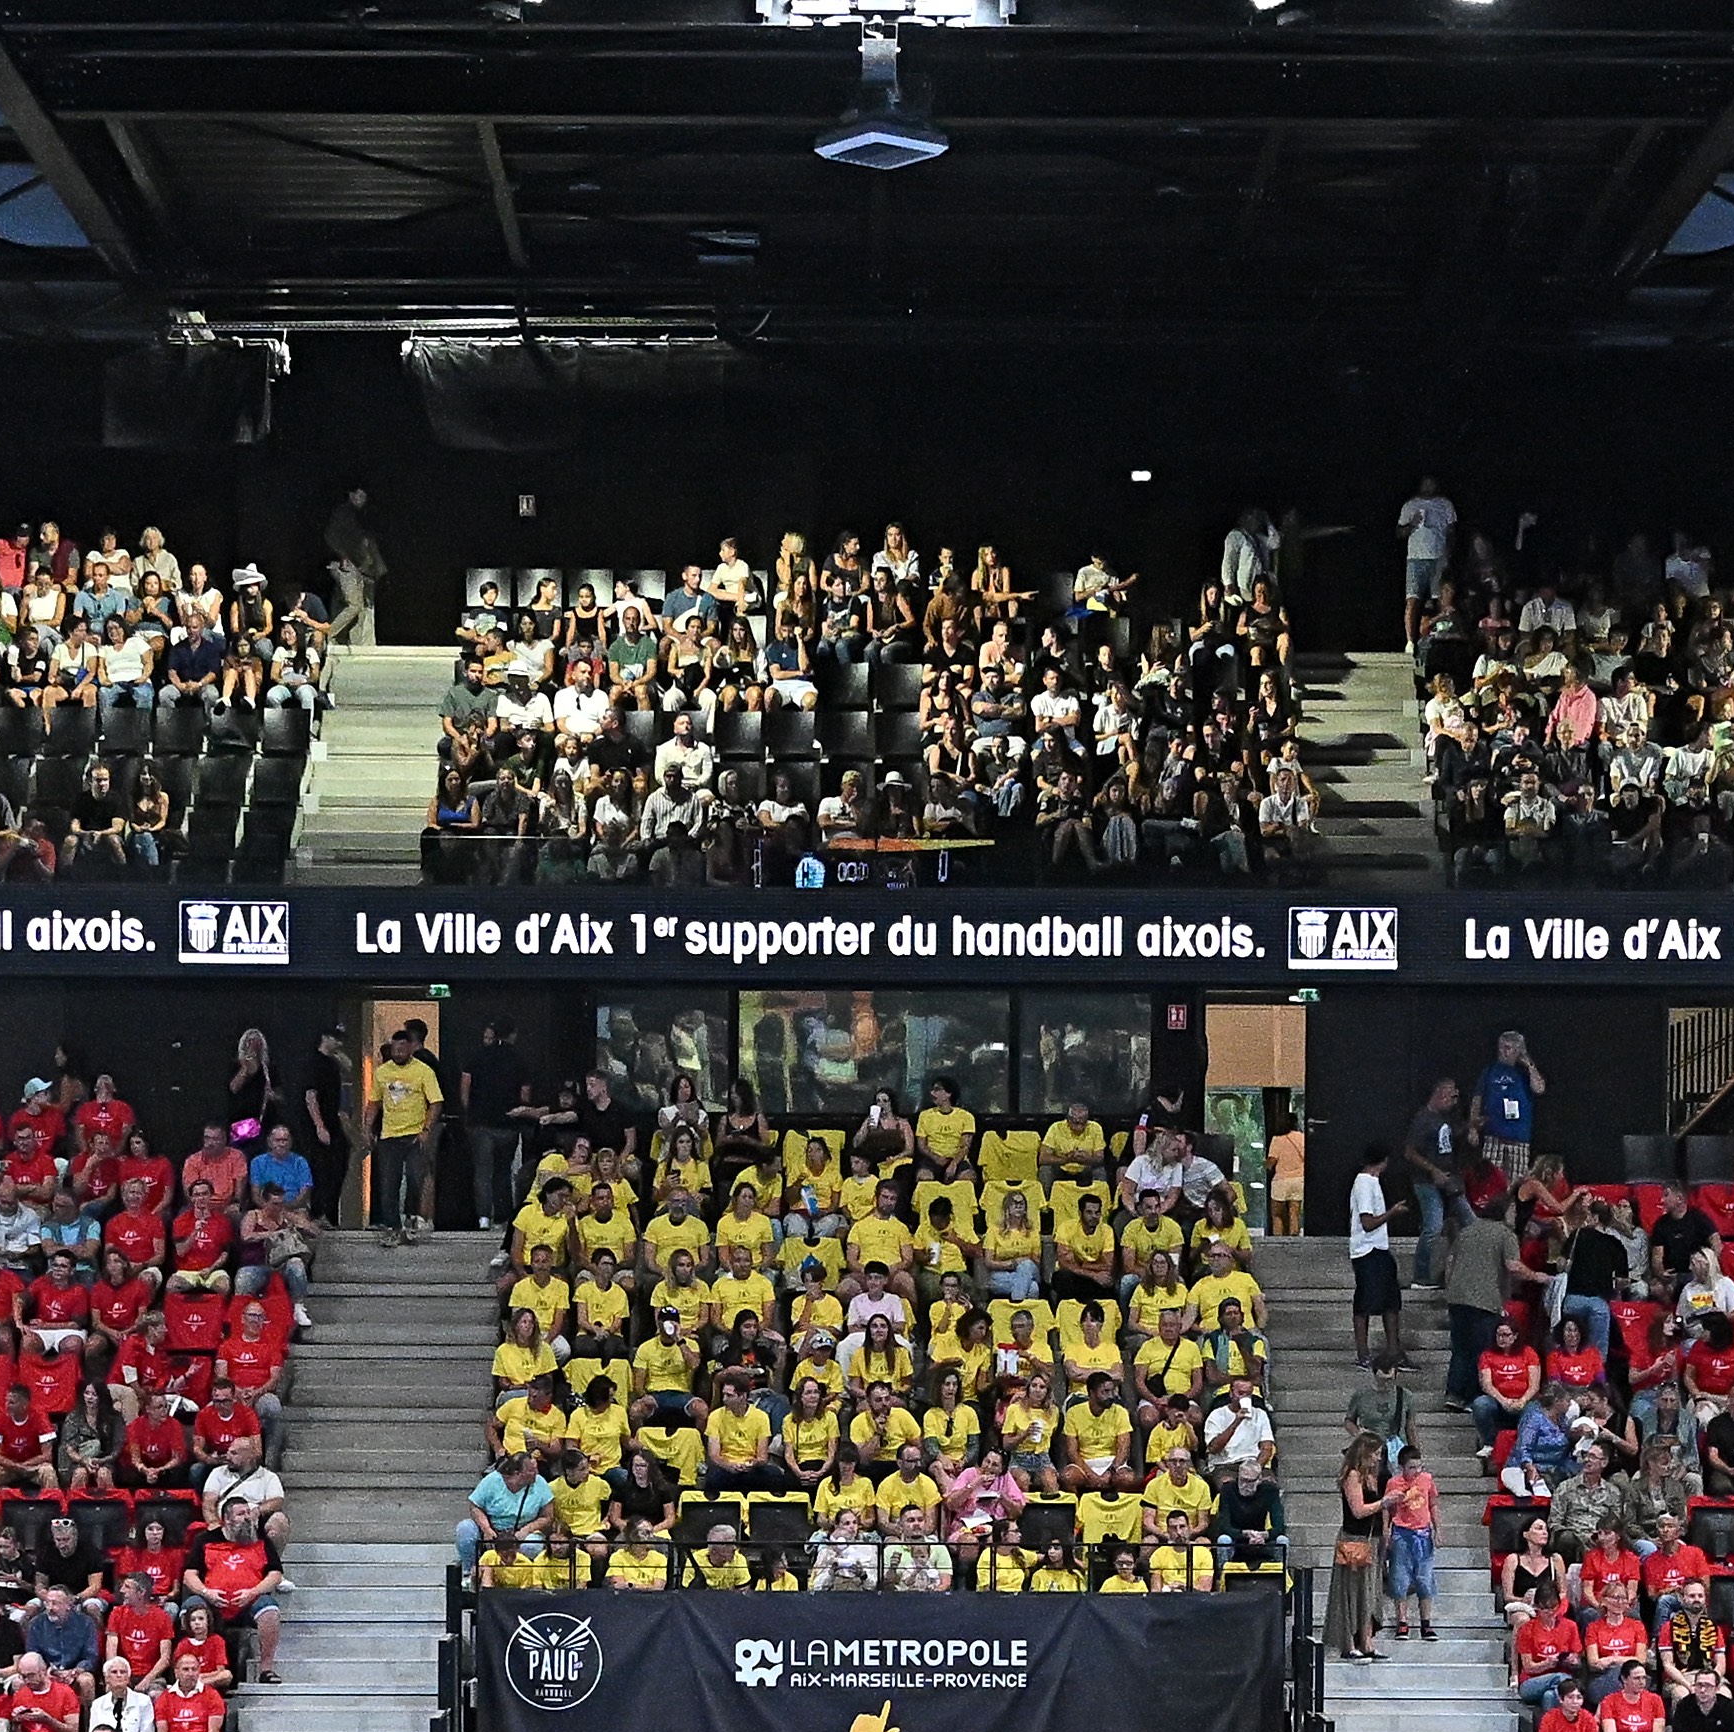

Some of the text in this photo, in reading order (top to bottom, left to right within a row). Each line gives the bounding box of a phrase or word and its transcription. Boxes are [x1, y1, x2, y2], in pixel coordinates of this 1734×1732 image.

[27, 910, 155, 951] aixois.
[223, 905, 286, 943] AIX
[357, 913, 400, 953] La
[416, 913, 501, 953] Ville
[516, 913, 613, 954] d'Aix
[685, 917, 875, 963] supporter
[888, 915, 936, 956] du
[953, 915, 1122, 956] handball
[1137, 916, 1265, 957] aixois.
[1332, 911, 1395, 949] AIX
[1466, 919, 1509, 958] La
[1525, 918, 1609, 959] Ville
[1623, 919, 1721, 959] d'Aix
[529, 1649, 579, 1681] PAUC
